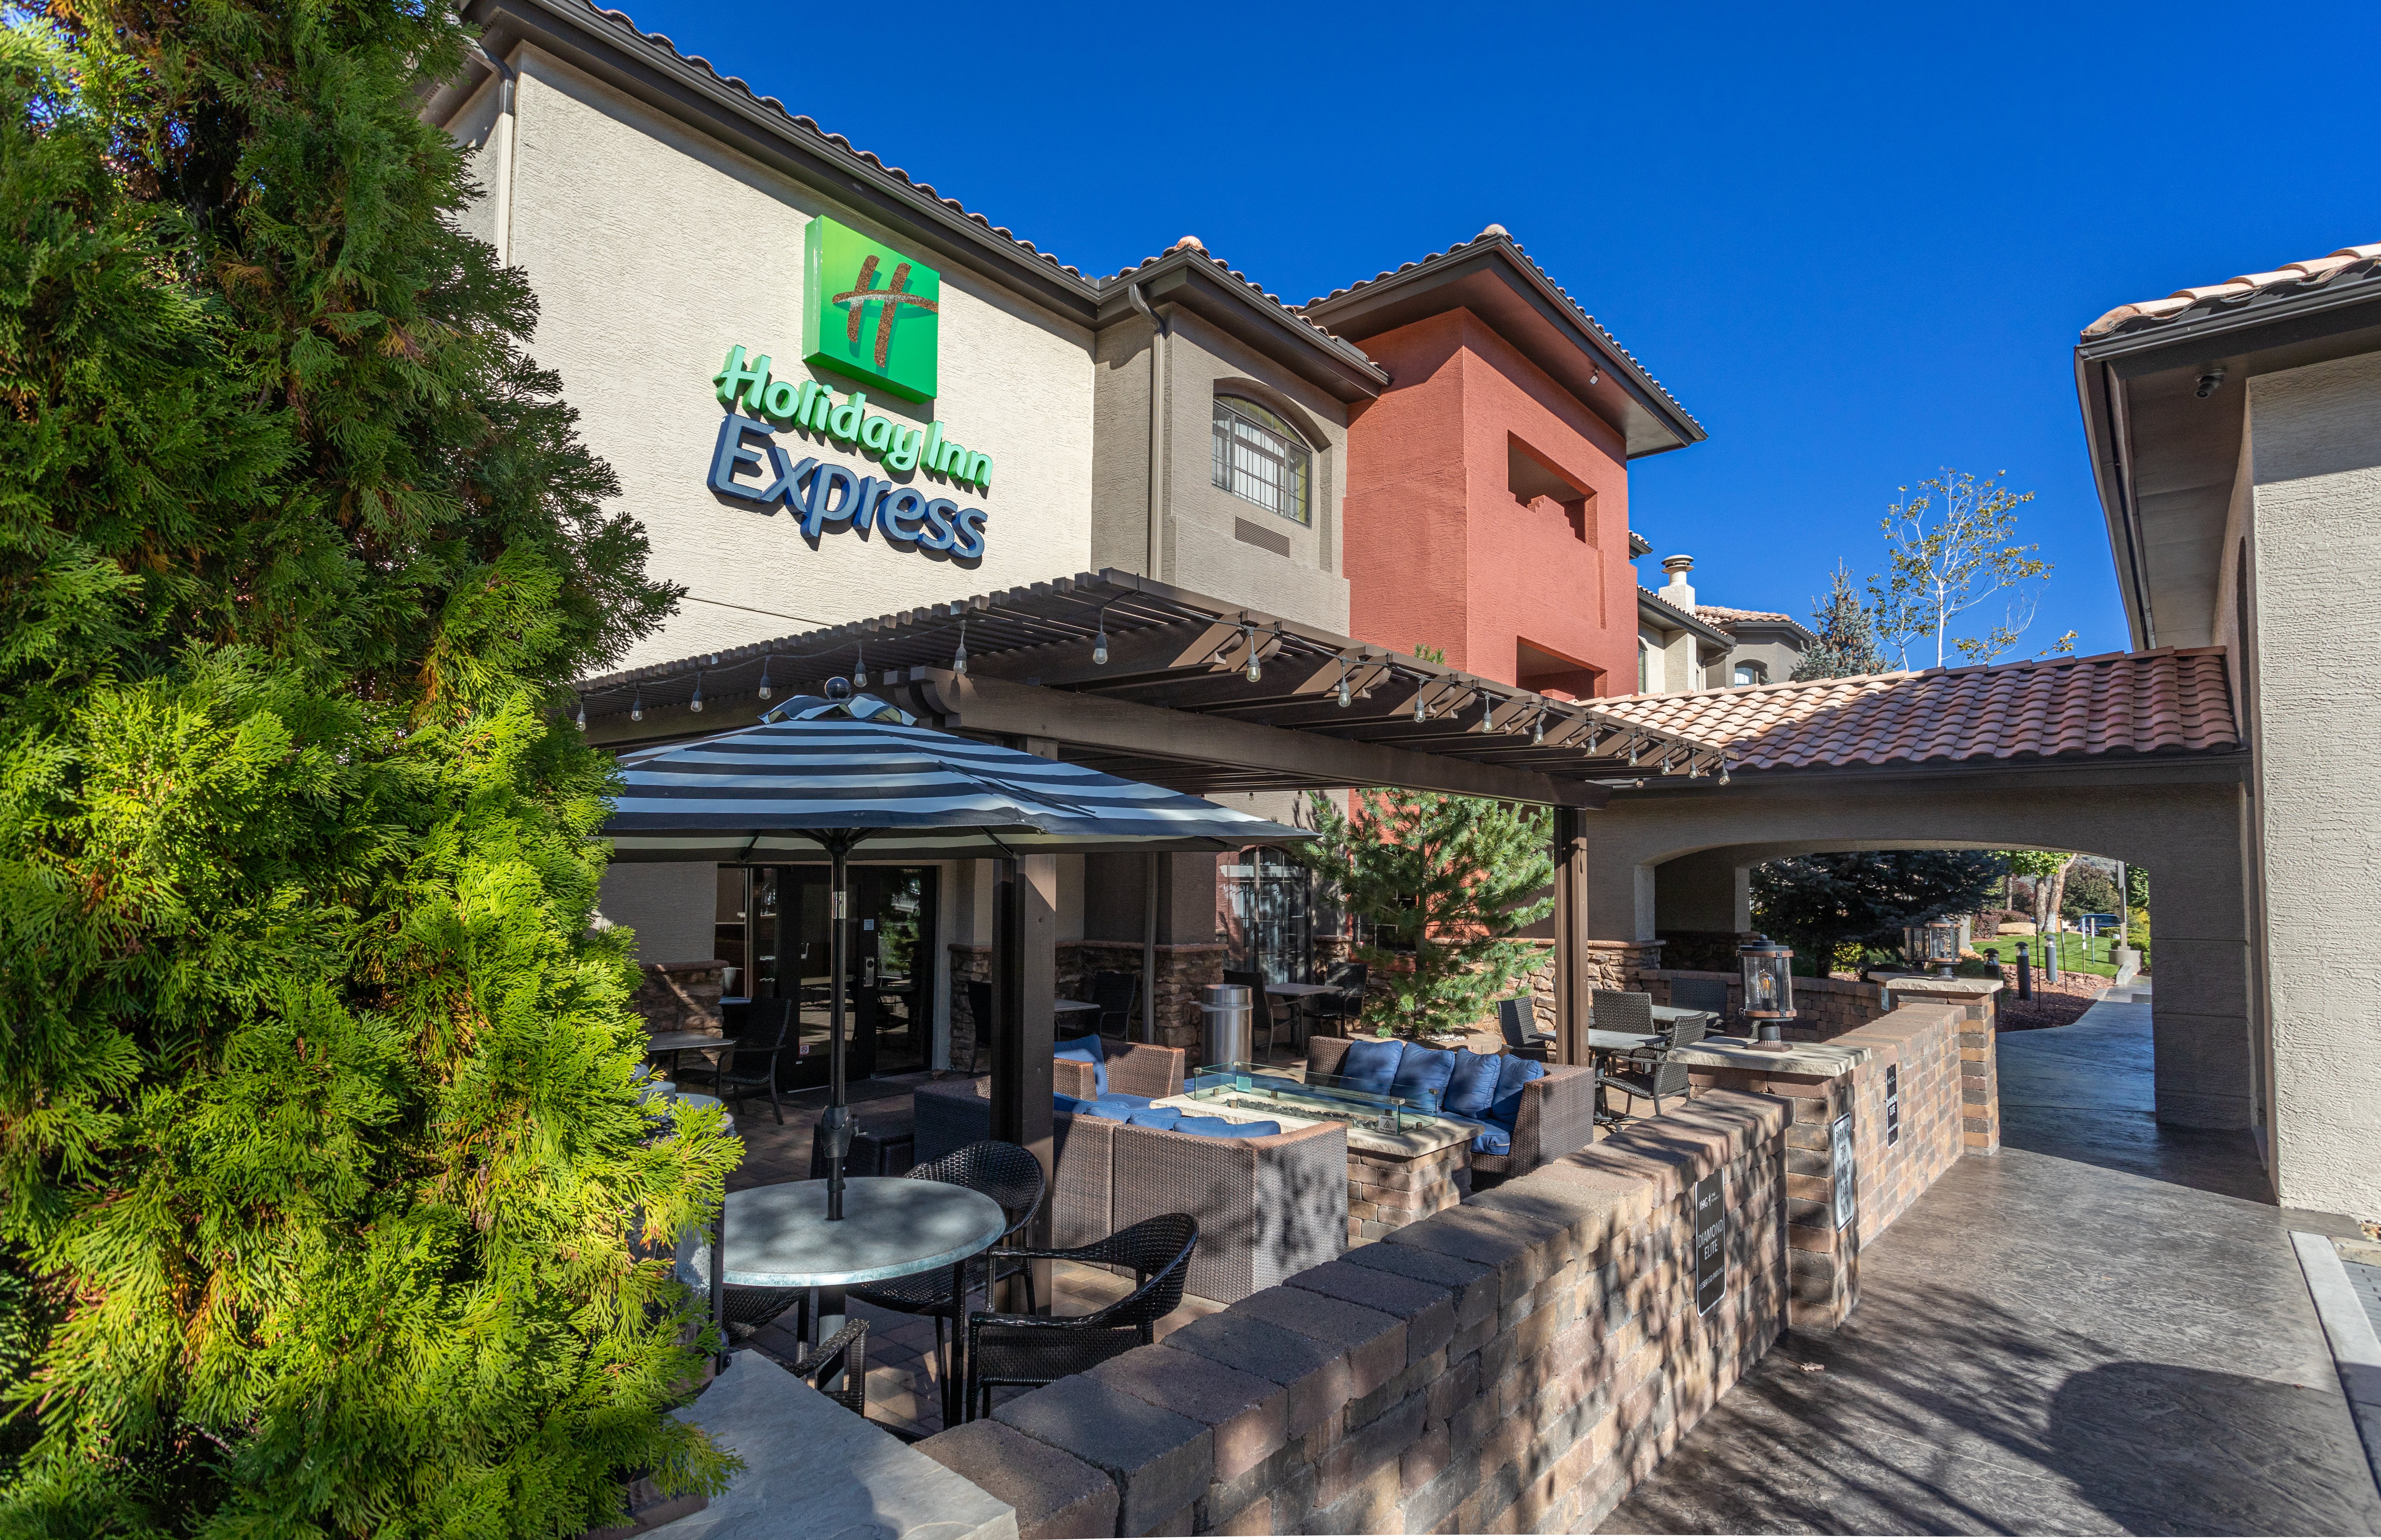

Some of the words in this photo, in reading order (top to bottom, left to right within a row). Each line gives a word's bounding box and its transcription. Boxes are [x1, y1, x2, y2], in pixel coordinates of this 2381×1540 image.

[712, 344, 922, 473] Holiday
[919, 420, 993, 489] Inn
[706, 413, 988, 560] Express
[1836, 1123, 1849, 1146] PARKING
[1837, 1159, 1850, 1184] COMPACT
[1699, 1197, 1708, 1211] IHG
[1698, 1219, 1723, 1248] DIAMOND
[1704, 1239, 1718, 1260] ELITE
[1699, 1274, 1712, 1291] RESERVED
[1713, 1265, 1724, 1280] PARKING
